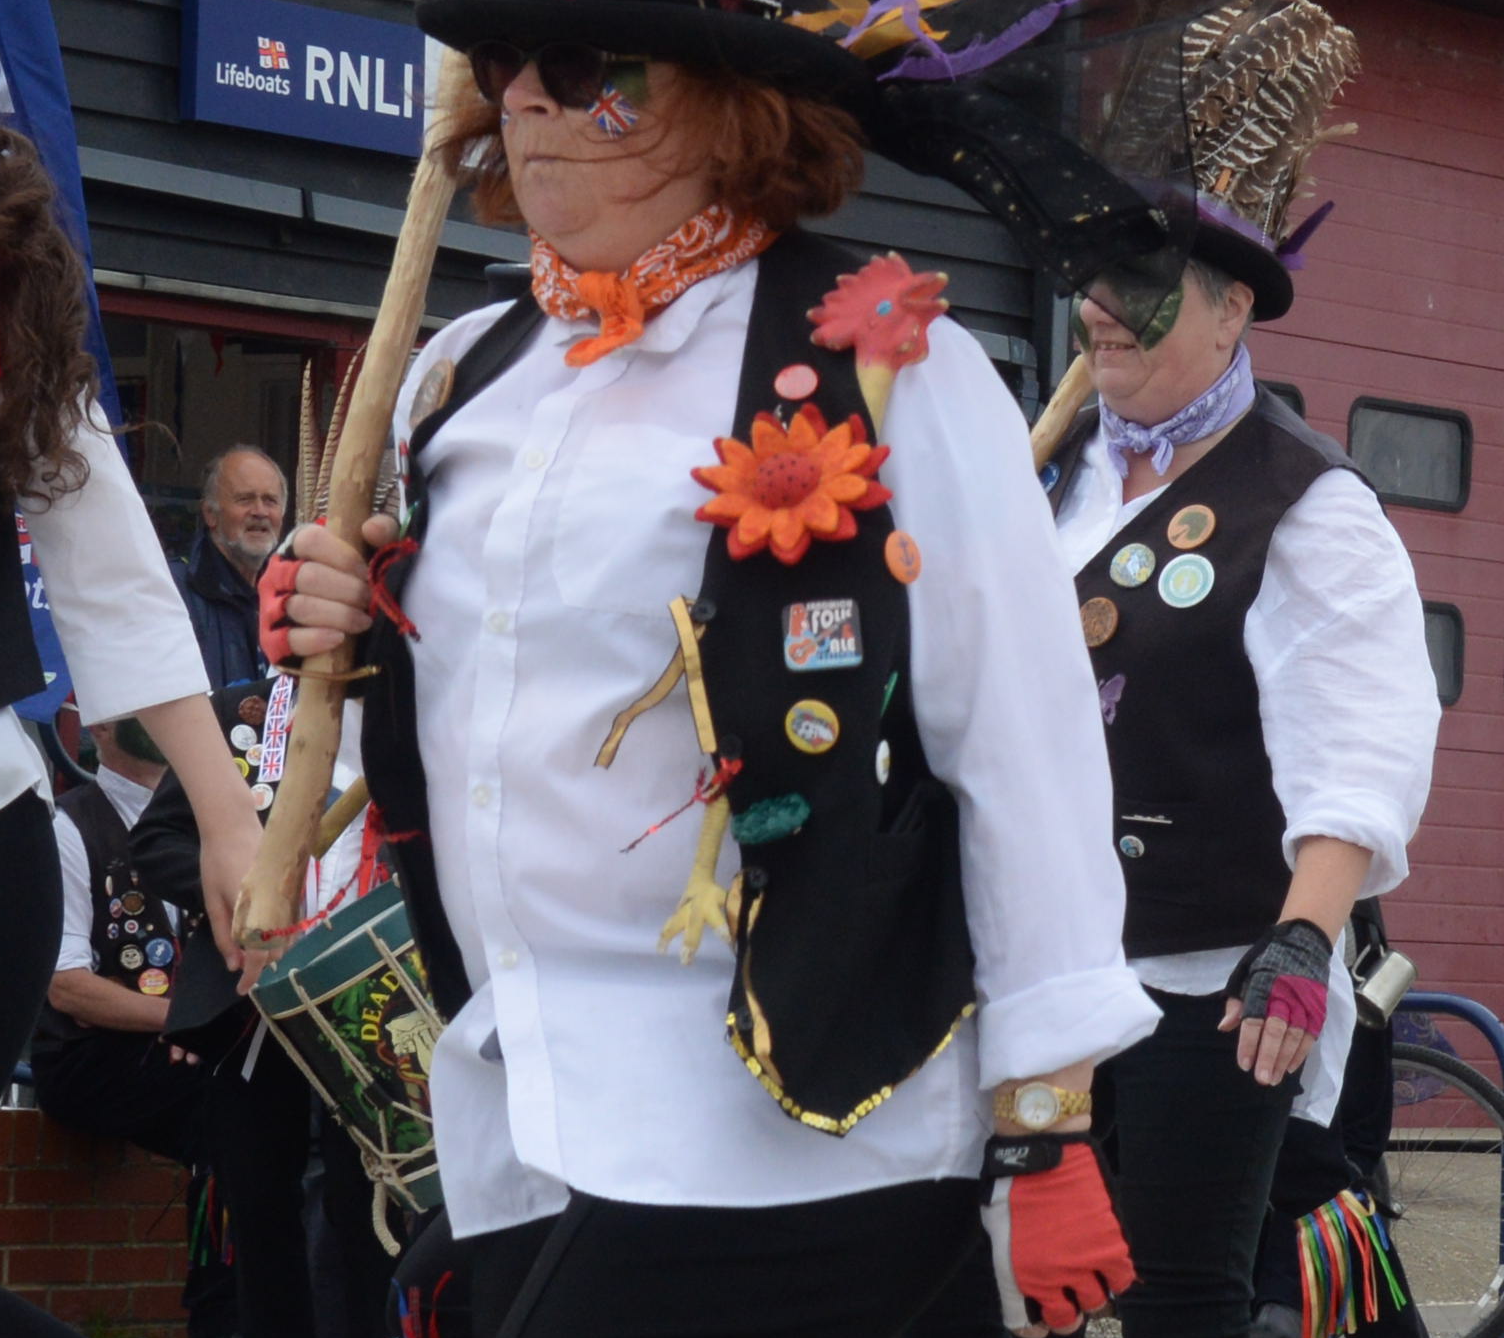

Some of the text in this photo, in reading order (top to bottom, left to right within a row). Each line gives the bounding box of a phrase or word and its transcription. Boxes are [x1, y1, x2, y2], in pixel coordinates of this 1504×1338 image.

[216, 61, 290, 96] Lifeboats
[305, 45, 413, 119] RNLI
[811, 608, 853, 635] FOLK
[830, 637, 856, 653] ALE
[360, 970, 401, 1041] DEAD
